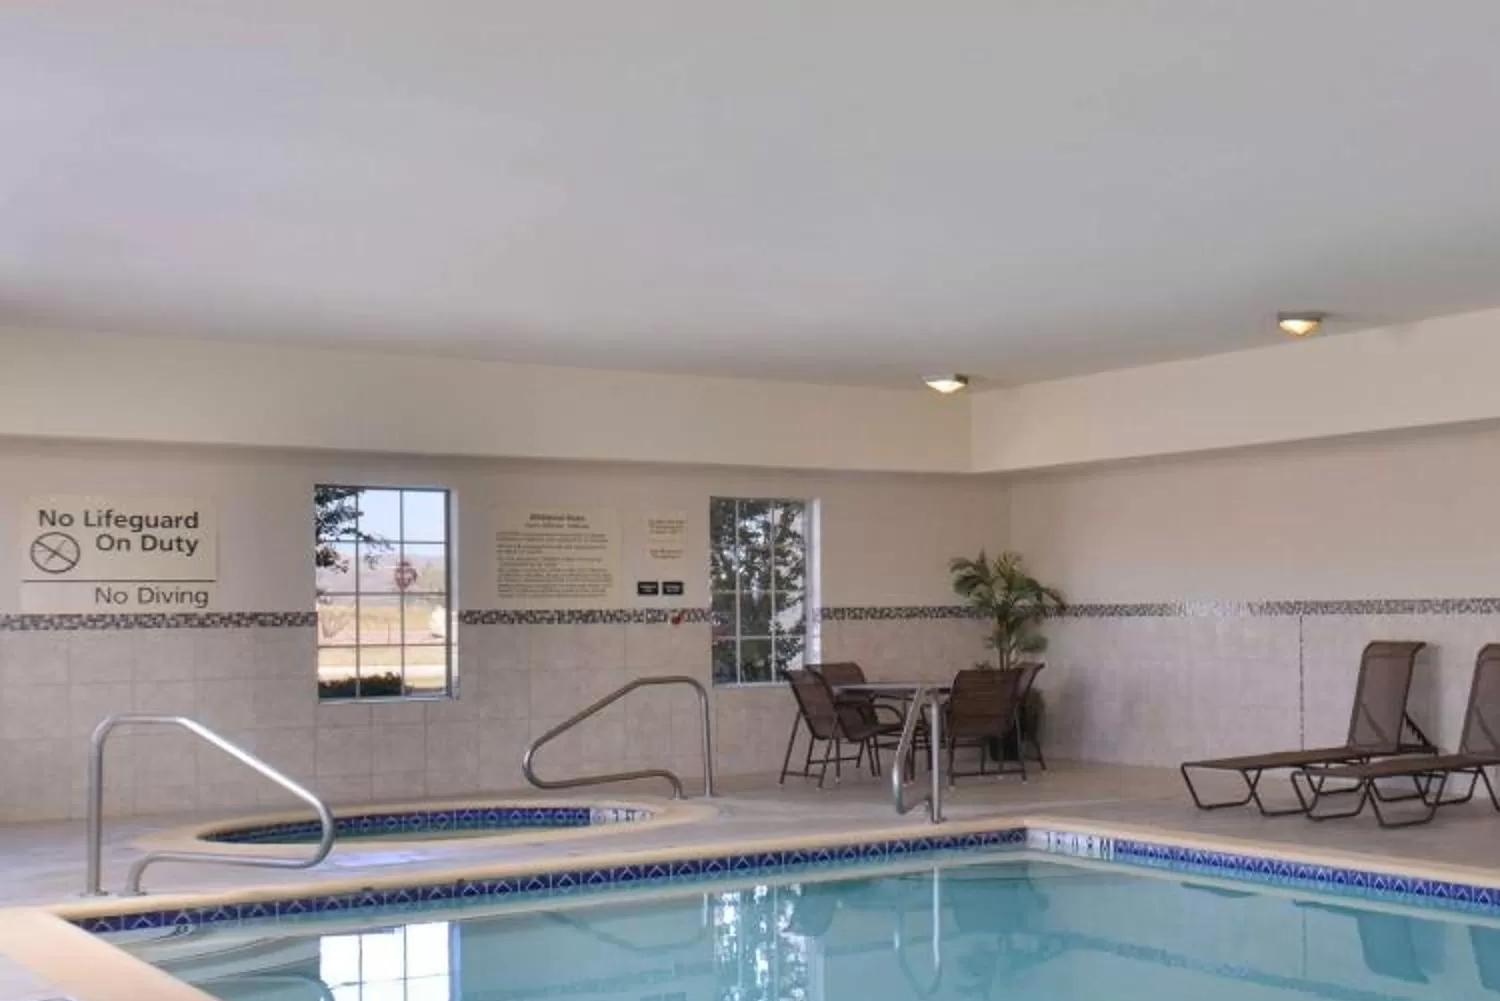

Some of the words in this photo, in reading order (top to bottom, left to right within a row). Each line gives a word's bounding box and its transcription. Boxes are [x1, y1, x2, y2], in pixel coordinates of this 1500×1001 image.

[38, 509, 74, 527] No
[84, 509, 199, 532] Lifeguard
[96, 533, 131, 552] On
[141, 534, 199, 557] Duty
[95, 587, 129, 605] No
[138, 587, 209, 608] Diving
